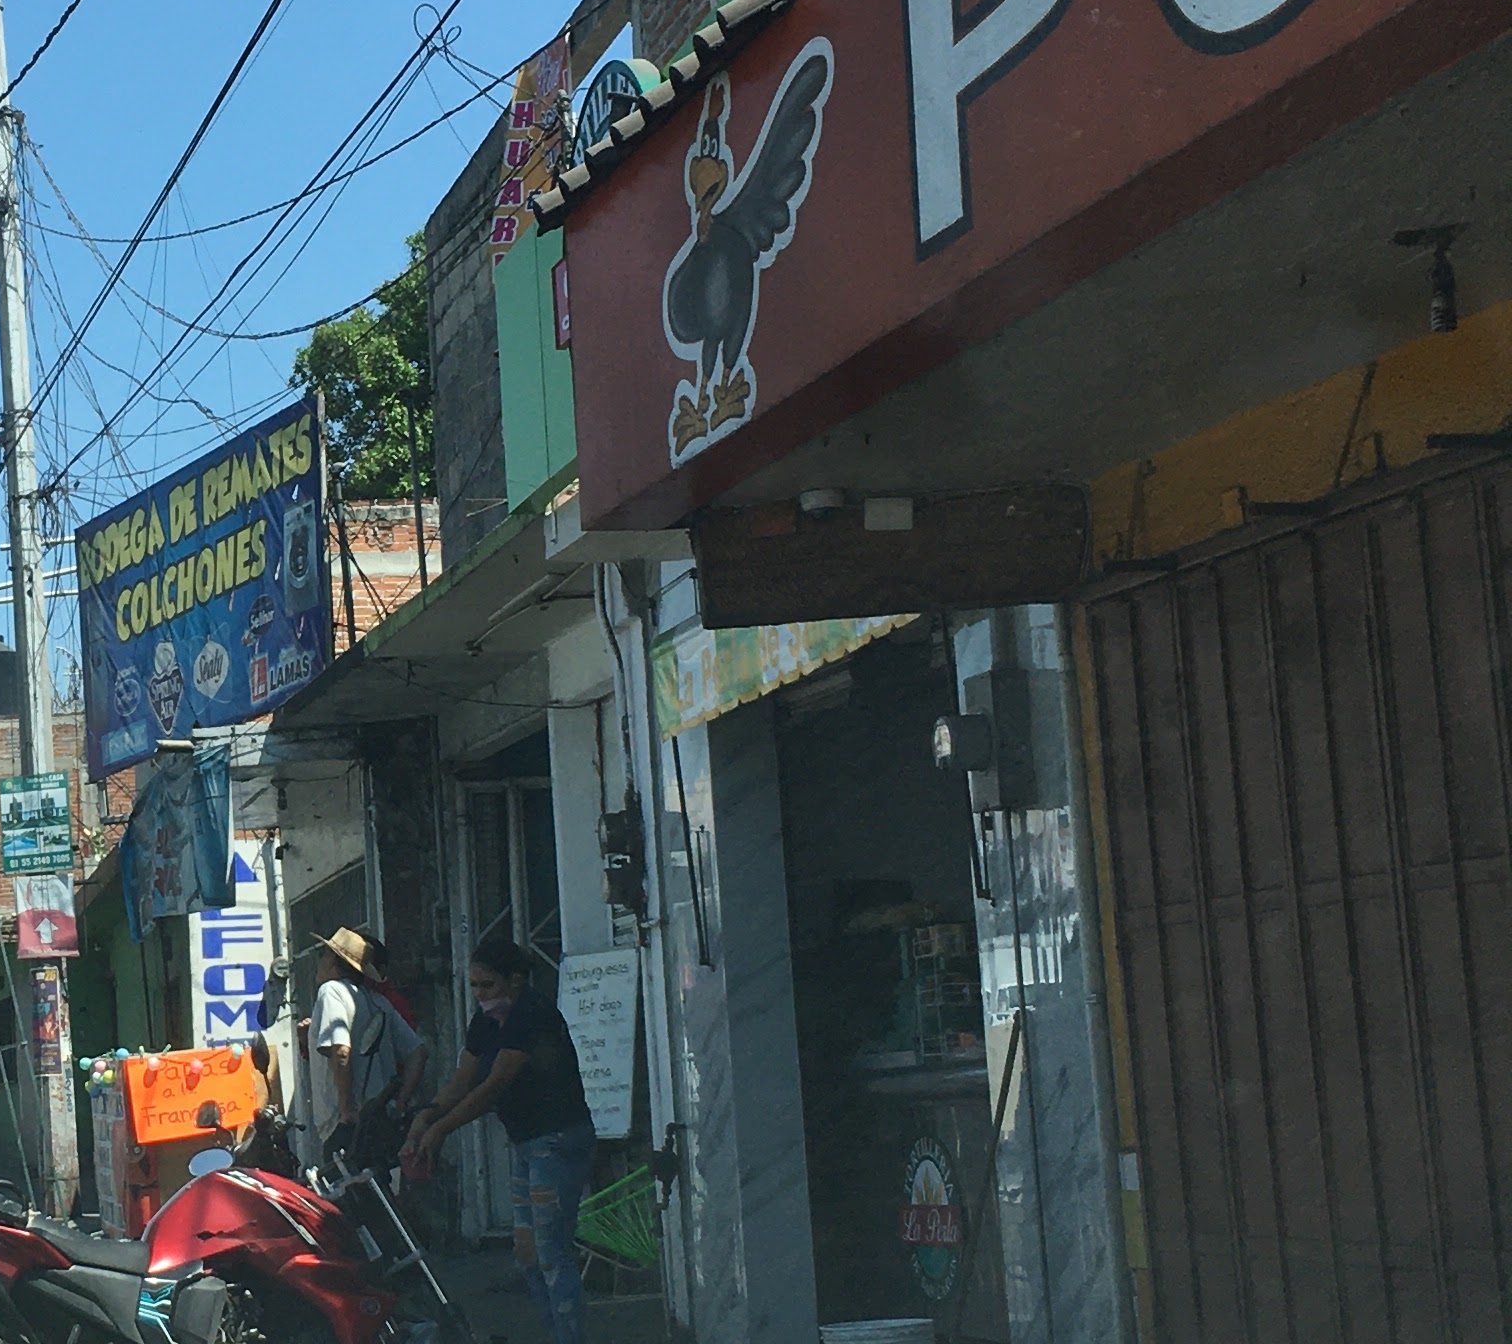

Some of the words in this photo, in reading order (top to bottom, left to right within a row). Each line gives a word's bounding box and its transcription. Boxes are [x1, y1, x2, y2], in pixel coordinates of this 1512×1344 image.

[490, 100, 536, 268] HUAR
[79, 500, 165, 591] BODEGA
[168, 476, 198, 545] DE
[201, 413, 312, 527] REMATES
[115, 519, 267, 642] COLCHONES
[270, 654, 310, 691] LAMAS
